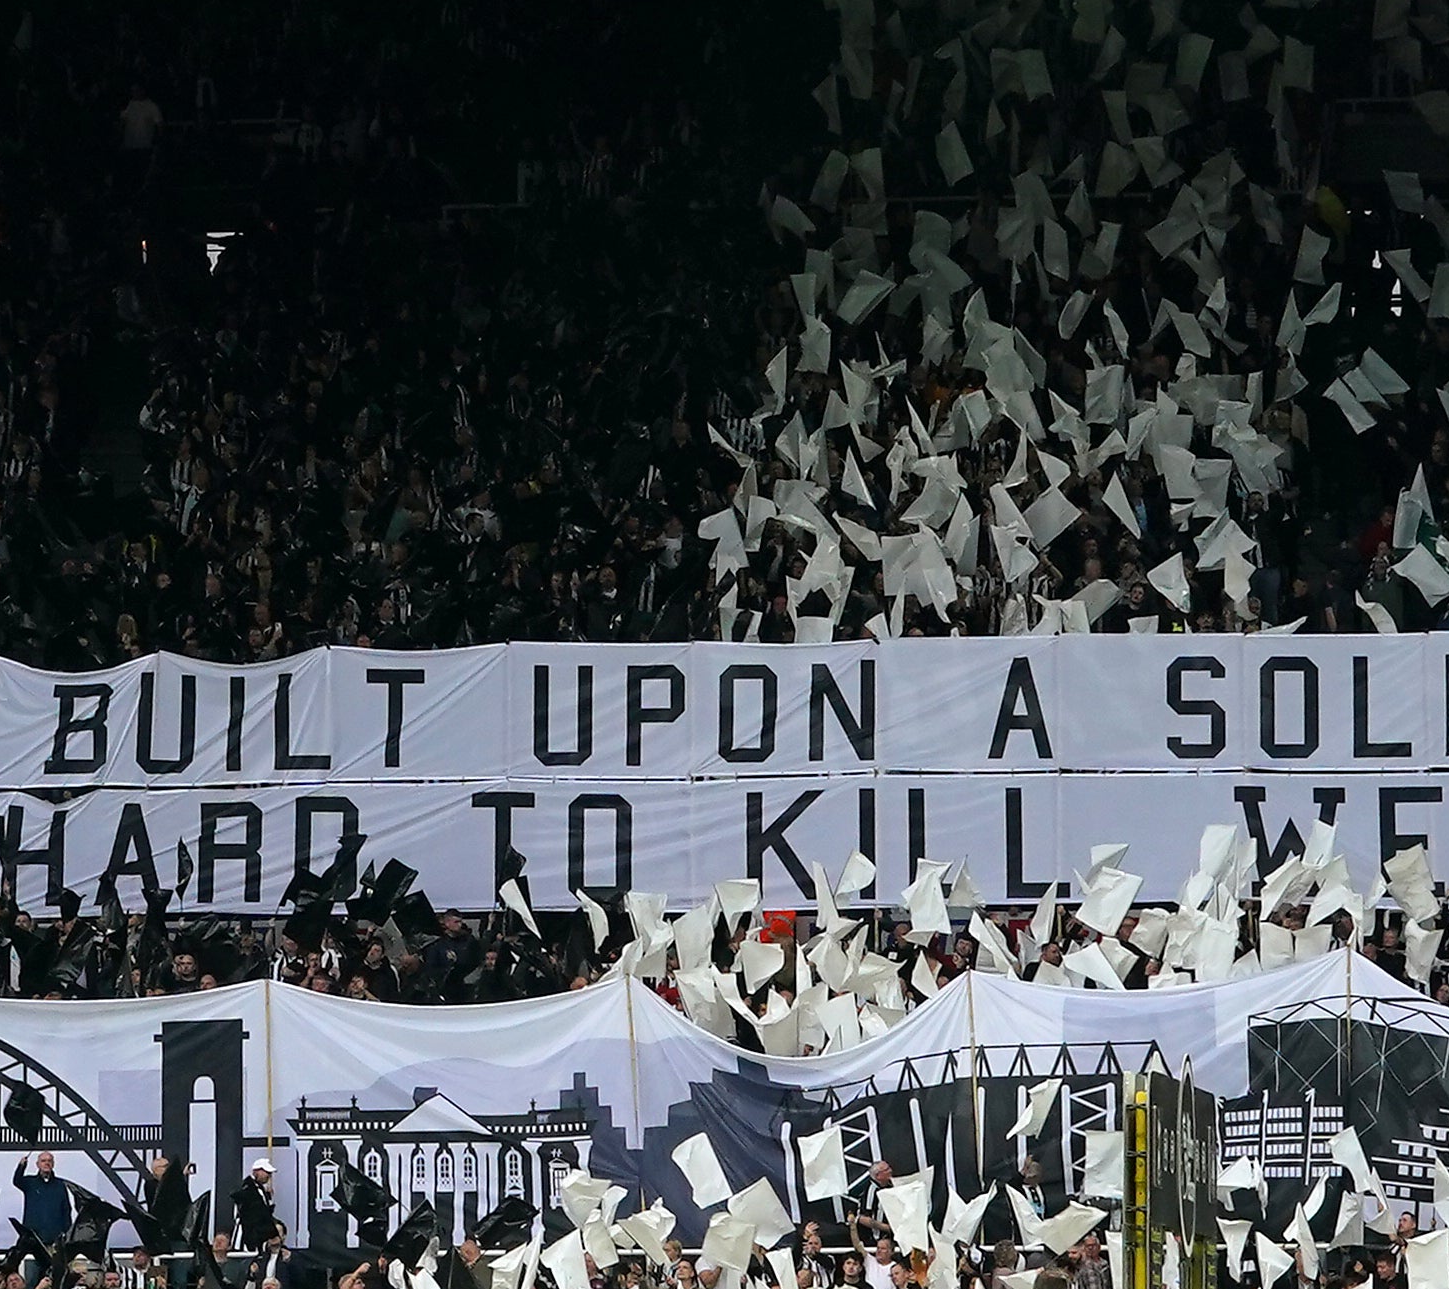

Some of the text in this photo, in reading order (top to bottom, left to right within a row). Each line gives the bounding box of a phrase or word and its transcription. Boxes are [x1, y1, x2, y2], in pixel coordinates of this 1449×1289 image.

[44, 668, 425, 775] BUILT
[532, 658, 876, 768] UPON
[988, 656, 1053, 760] A
[0, 795, 360, 907] HARD
[471, 791, 633, 899] TO
[744, 787, 1071, 902] KILL
[1232, 785, 1445, 902] WE
